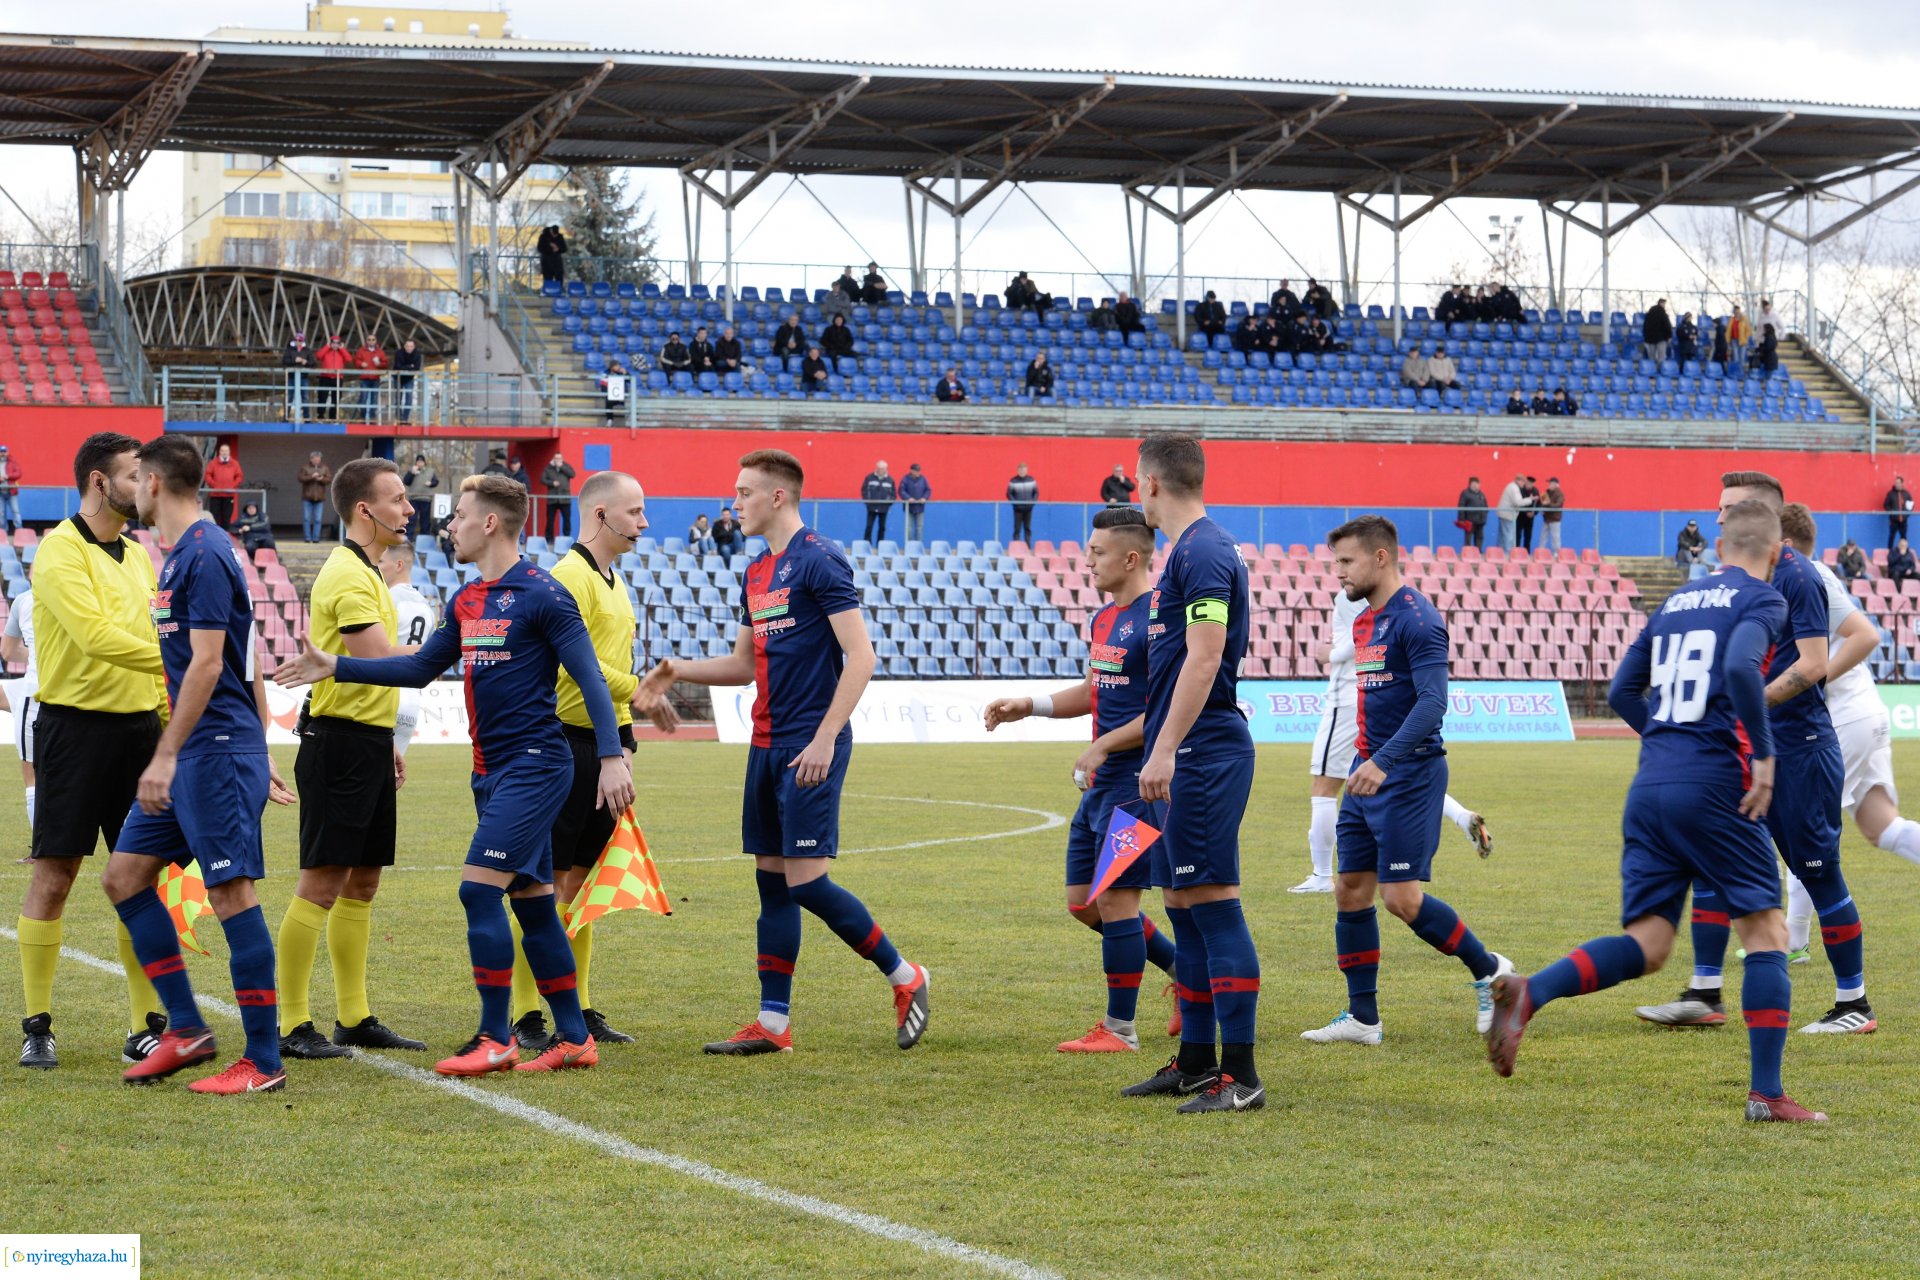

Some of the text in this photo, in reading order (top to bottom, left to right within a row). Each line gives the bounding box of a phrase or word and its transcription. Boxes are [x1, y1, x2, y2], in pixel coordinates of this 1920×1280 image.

[611, 386, 621, 398] C
[439, 504, 447, 516] D
[1192, 602, 1208, 620] C
[406, 616, 426, 646] 8
[1650, 629, 1717, 724] 48
[1275, 723, 1319, 733] ALKAT
[796, 840, 818, 848] JAKO
[484, 849, 507, 860] JAKO
[1175, 865, 1195, 875] JAKO
[1390, 862, 1411, 871] JAKO
